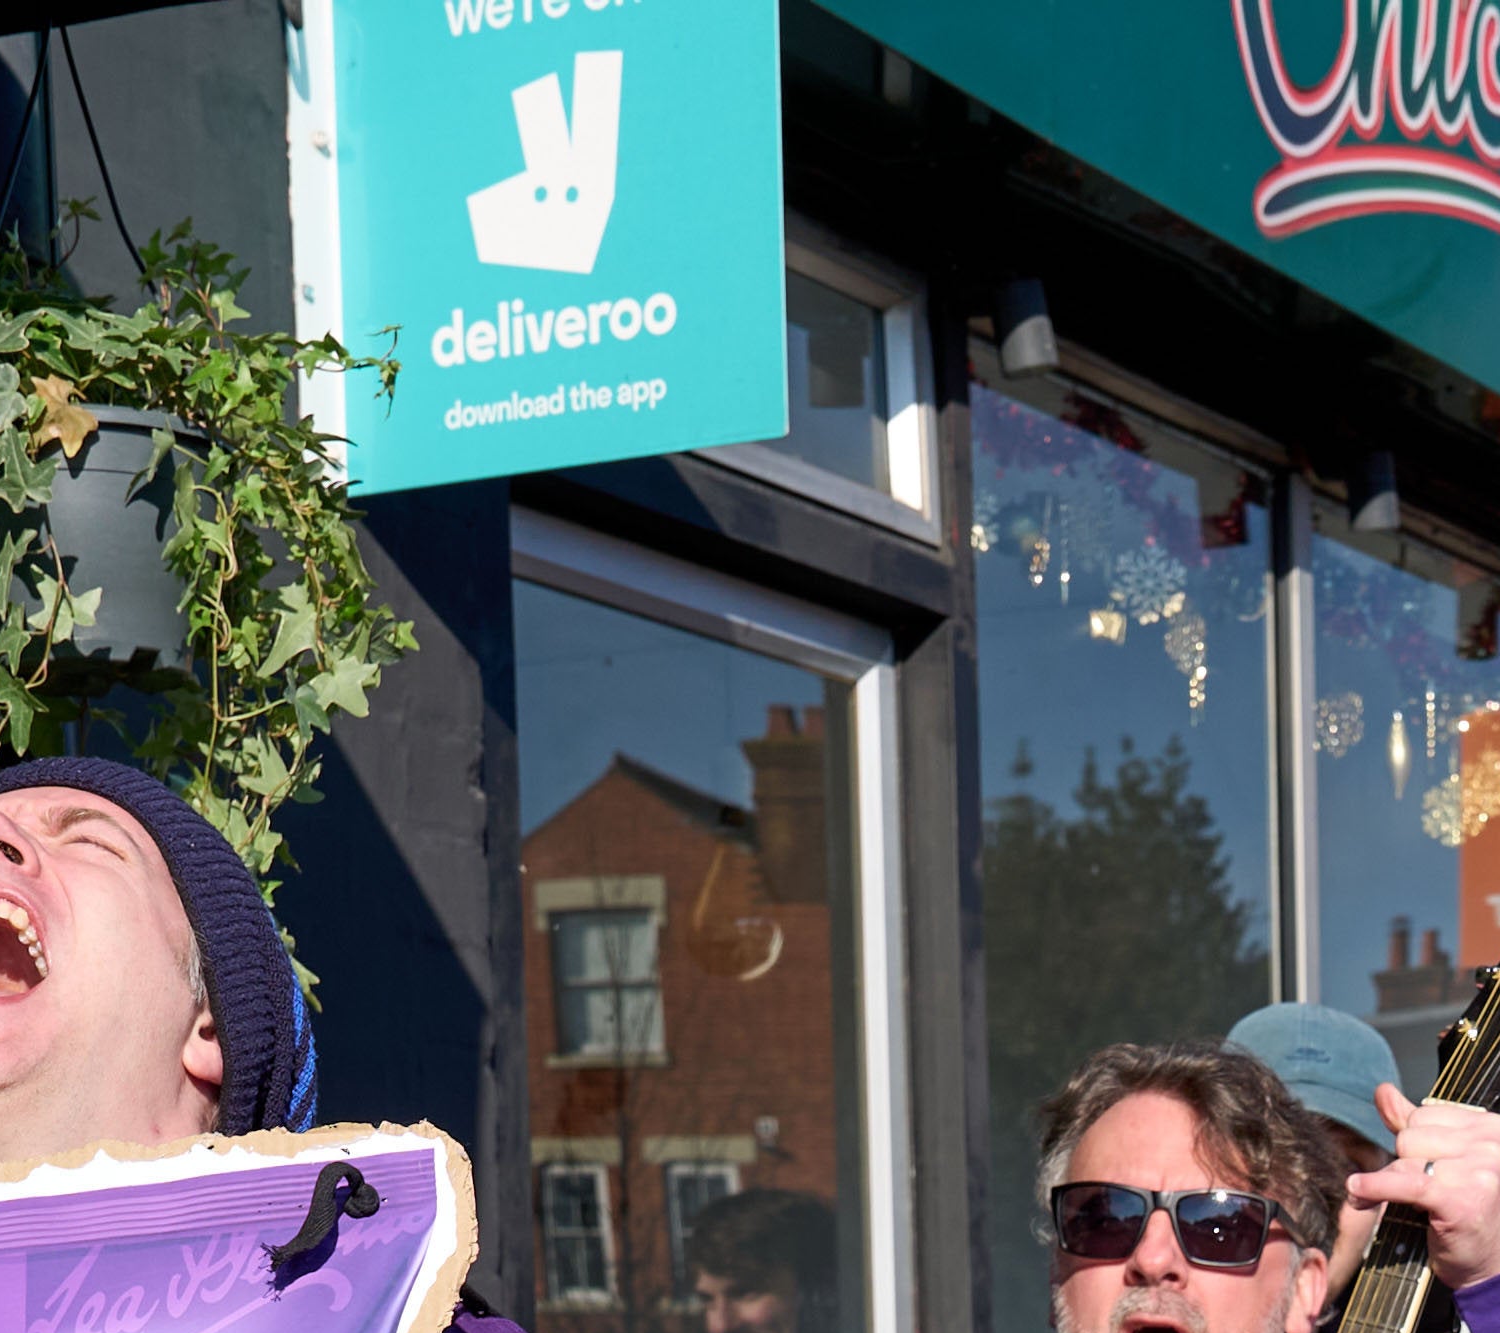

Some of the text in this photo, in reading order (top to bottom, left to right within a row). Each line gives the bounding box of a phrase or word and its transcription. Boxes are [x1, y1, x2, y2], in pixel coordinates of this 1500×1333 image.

[432, 292, 677, 368] deliveroo
[444, 377, 666, 430] download the app
